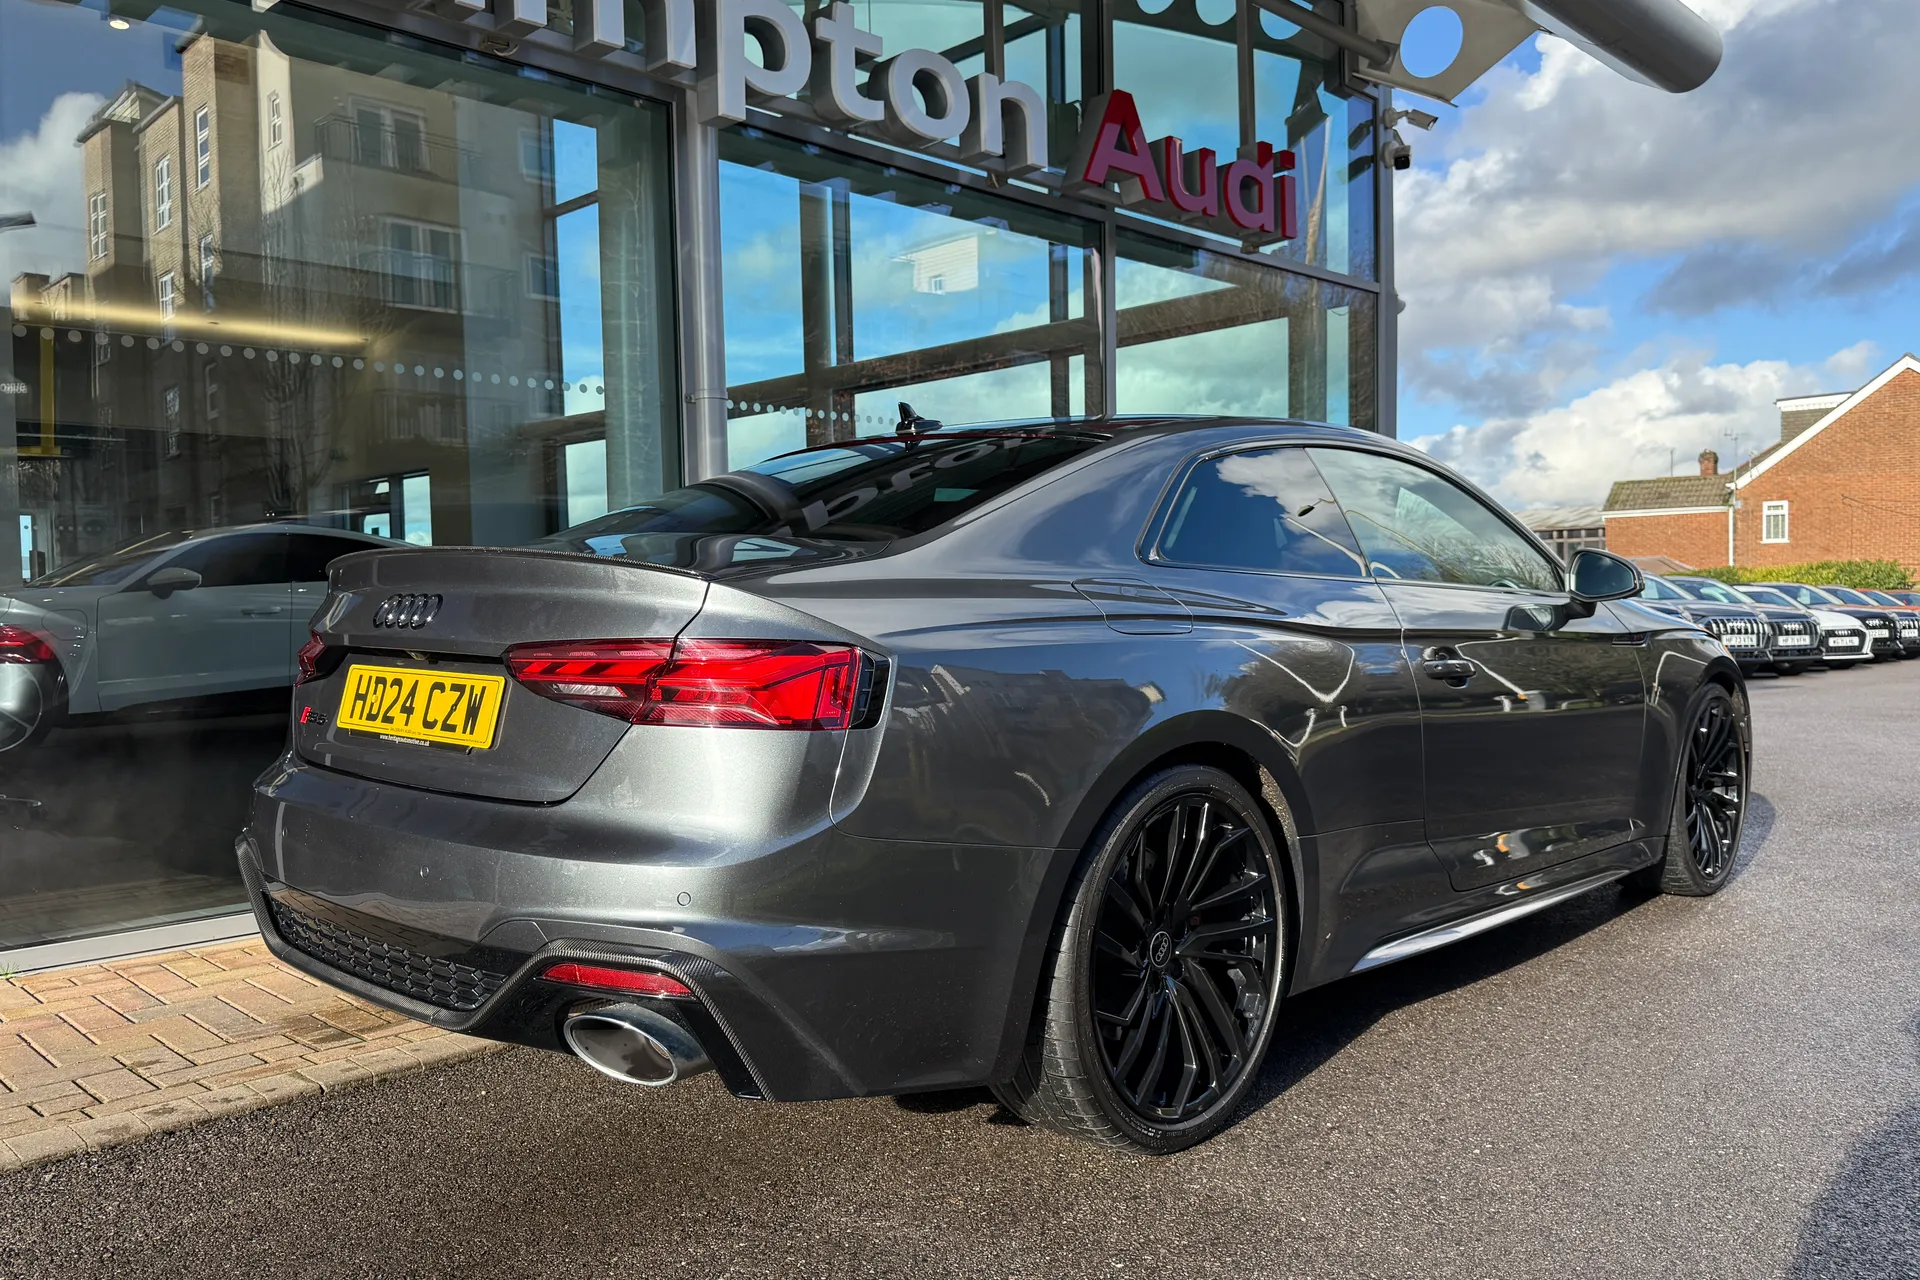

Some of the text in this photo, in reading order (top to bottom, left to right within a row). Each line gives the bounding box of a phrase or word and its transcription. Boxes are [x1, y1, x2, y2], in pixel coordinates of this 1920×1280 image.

[452, 0, 1297, 239] pton Audi
[350, 674, 487, 735] HD24 CZW
